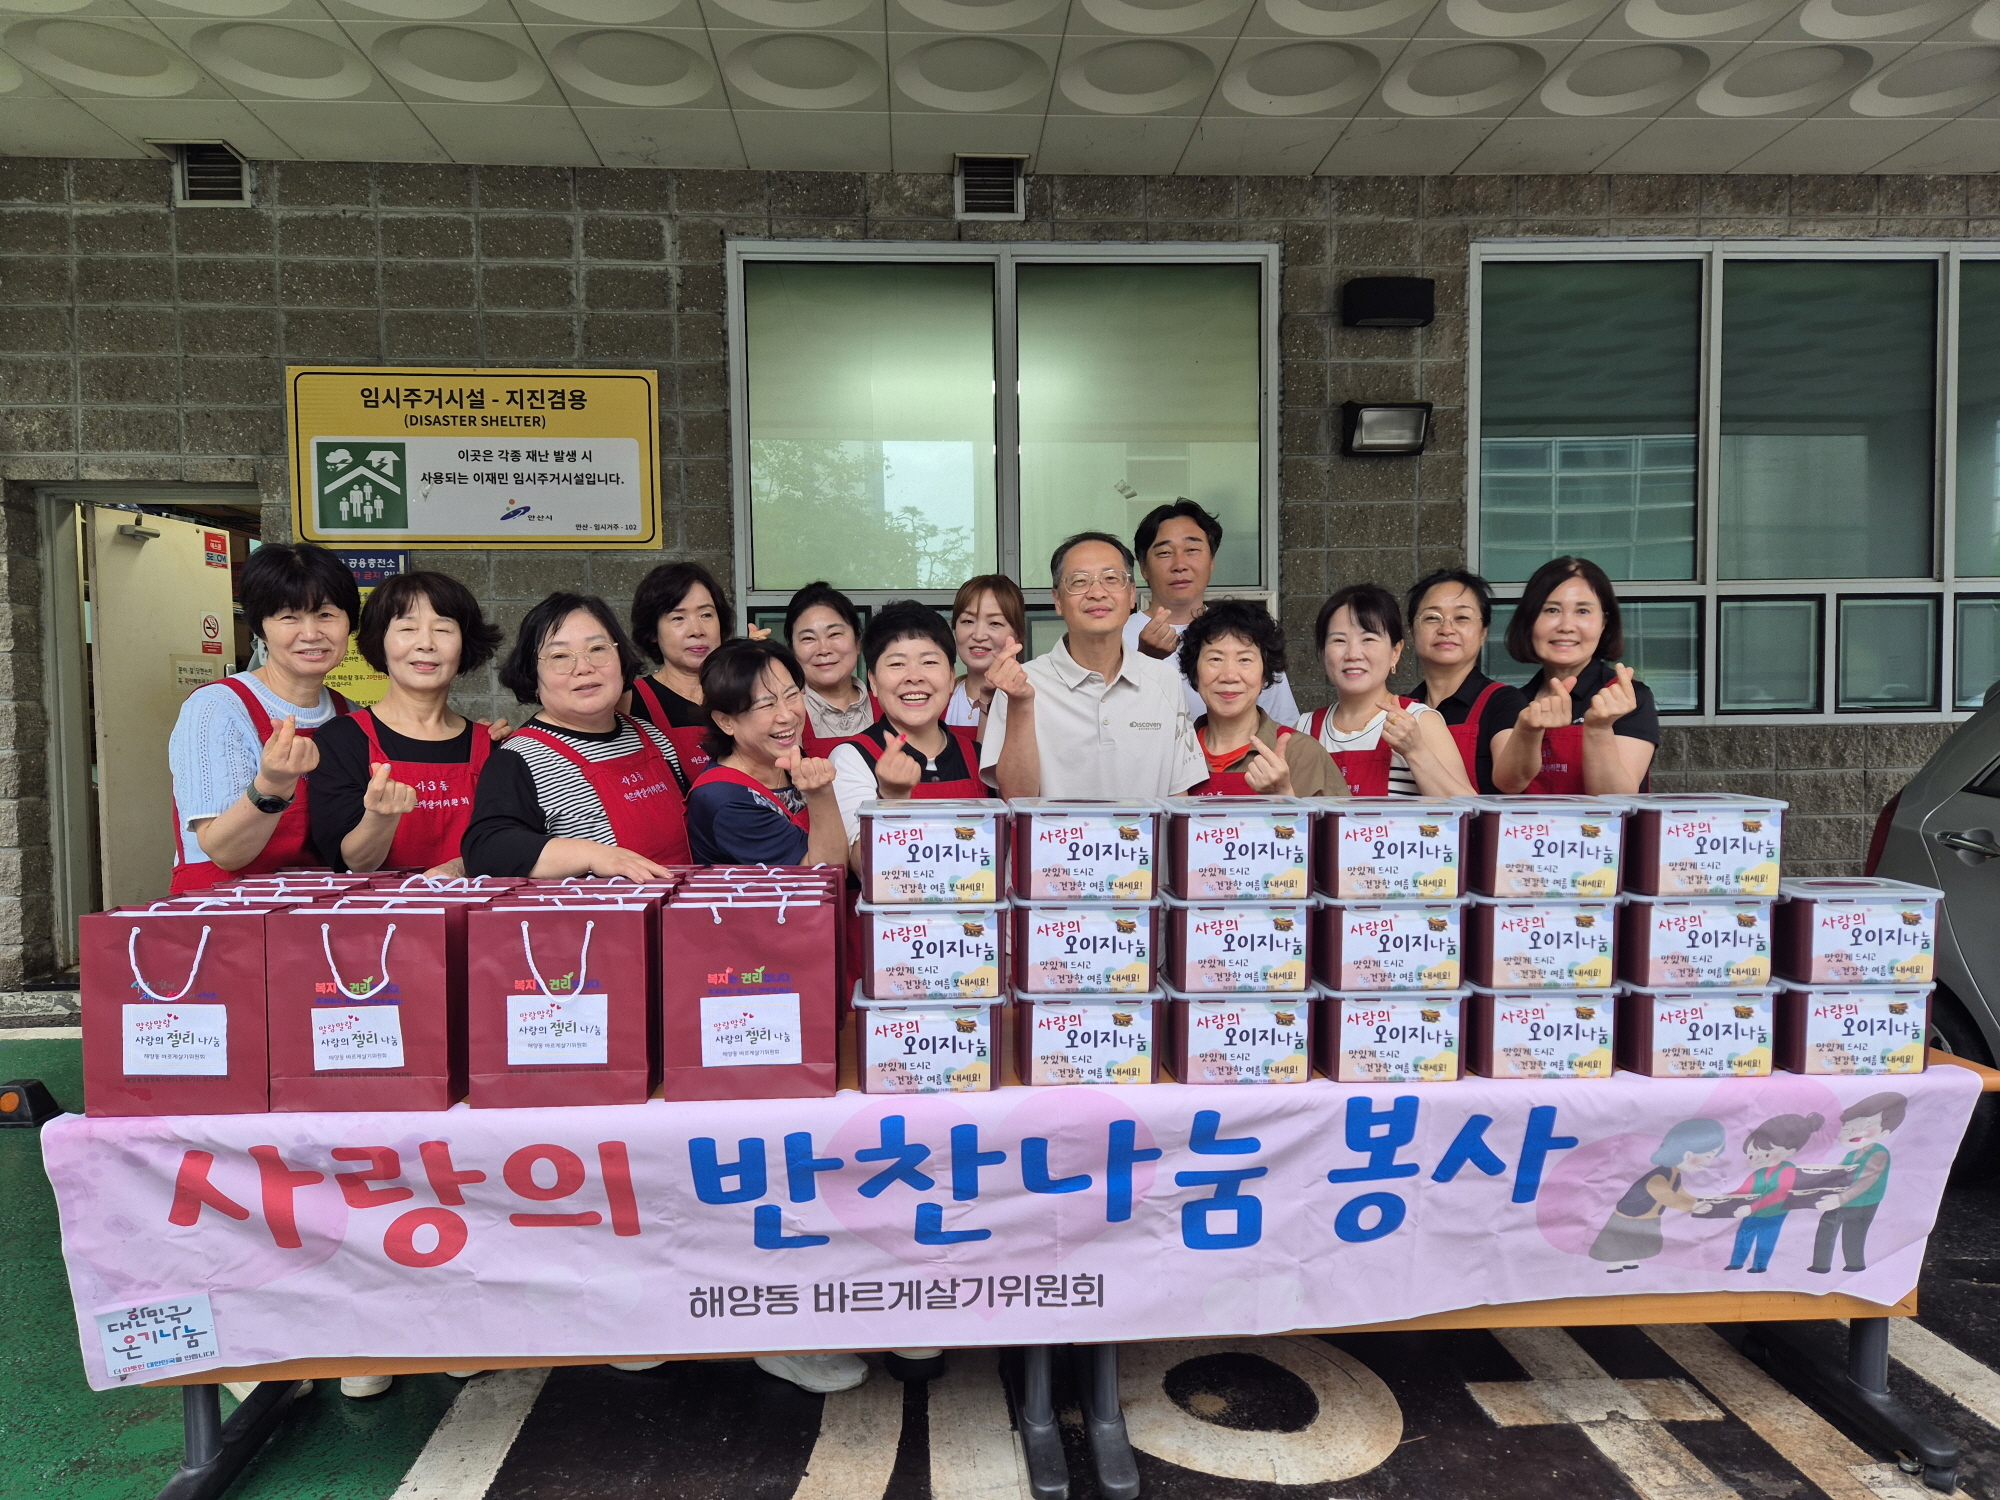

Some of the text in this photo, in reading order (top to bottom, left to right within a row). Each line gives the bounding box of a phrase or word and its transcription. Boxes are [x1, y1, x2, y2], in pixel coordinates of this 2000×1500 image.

[360, 387, 485, 410] 임시주거시설
[505, 388, 588, 411] 지진겸용
[404, 414, 546, 429] (DISASTER SHELTER)
[458, 449, 592, 463] 이곳은 각종 재난 발생 시
[420, 472, 625, 486] 사용되는 이재민 임시주거시설입니다.
[206, 553, 227, 563] SECOM
[348, 558, 396, 569] 공용충전소
[364, 571, 381, 580] 금지
[878, 829, 924, 846] 사랑의
[1040, 827, 1084, 844] 사랑의
[1196, 827, 1240, 844] 사랑의
[1345, 826, 1389, 843] 사랑의
[1505, 823, 1550, 841] 사랑의
[1667, 822, 1712, 838] 사랑의
[882, 870, 935, 881] 맛있게 드시고
[1042, 867, 1094, 878] 맛있게 드시고
[899, 882, 985, 895] 건강한 여름 보내세요!
[1059, 880, 1143, 893] 건강한 여름 보내세요!
[1037, 921, 1081, 937] 사랑의
[1196, 919, 1240, 936] 사랑의
[1351, 920, 1394, 936] 사랑의
[1502, 917, 1546, 933] 사랑의
[1659, 916, 1703, 932] 사랑의
[1822, 913, 1867, 930] 사랑의
[882, 925, 928, 943] 사랑의
[886, 966, 939, 977] 맛있게 드시고
[904, 977, 989, 990] 건강한 여름 보내세요!
[519, 1009, 554, 1022] 말랑말랑
[1347, 1010, 1391, 1027] 사랑의
[1501, 1008, 1546, 1025] 사랑의
[1660, 1008, 1704, 1025] 사랑의
[1815, 1004, 1859, 1020] 사랑의
[135, 1019, 171, 1032] 말랑말랑
[319, 1021, 352, 1035] 말랑말랑
[519, 1026, 547, 1036] 사랑의
[550, 1021, 576, 1037] 젤리
[713, 1018, 747, 1032] 말랑말랑
[875, 1021, 920, 1038] 사랑의
[1038, 1015, 1083, 1031] 사랑의
[1197, 1013, 1241, 1030] 사랑의
[135, 1036, 164, 1046] 사랑의
[167, 1032, 195, 1048] 젤리
[321, 1032, 398, 1048] 사랑의 젤리 나눔
[715, 1029, 791, 1045] 사랑의 젤리 나눔
[1041, 1055, 1093, 1066] 맛있게 드시고
[1057, 1067, 1141, 1079] 건강한 여름 보내세요!
[167, 1095, 1579, 1268] 사랑의 반찬나눔 봉사
[688, 1273, 1105, 1318] 해양동 바르게살기위원회
[107, 1305, 193, 1333] 대한민국
[112, 1324, 208, 1360] 온기나눔
[184, 1350, 215, 1362] 만듭니다!
